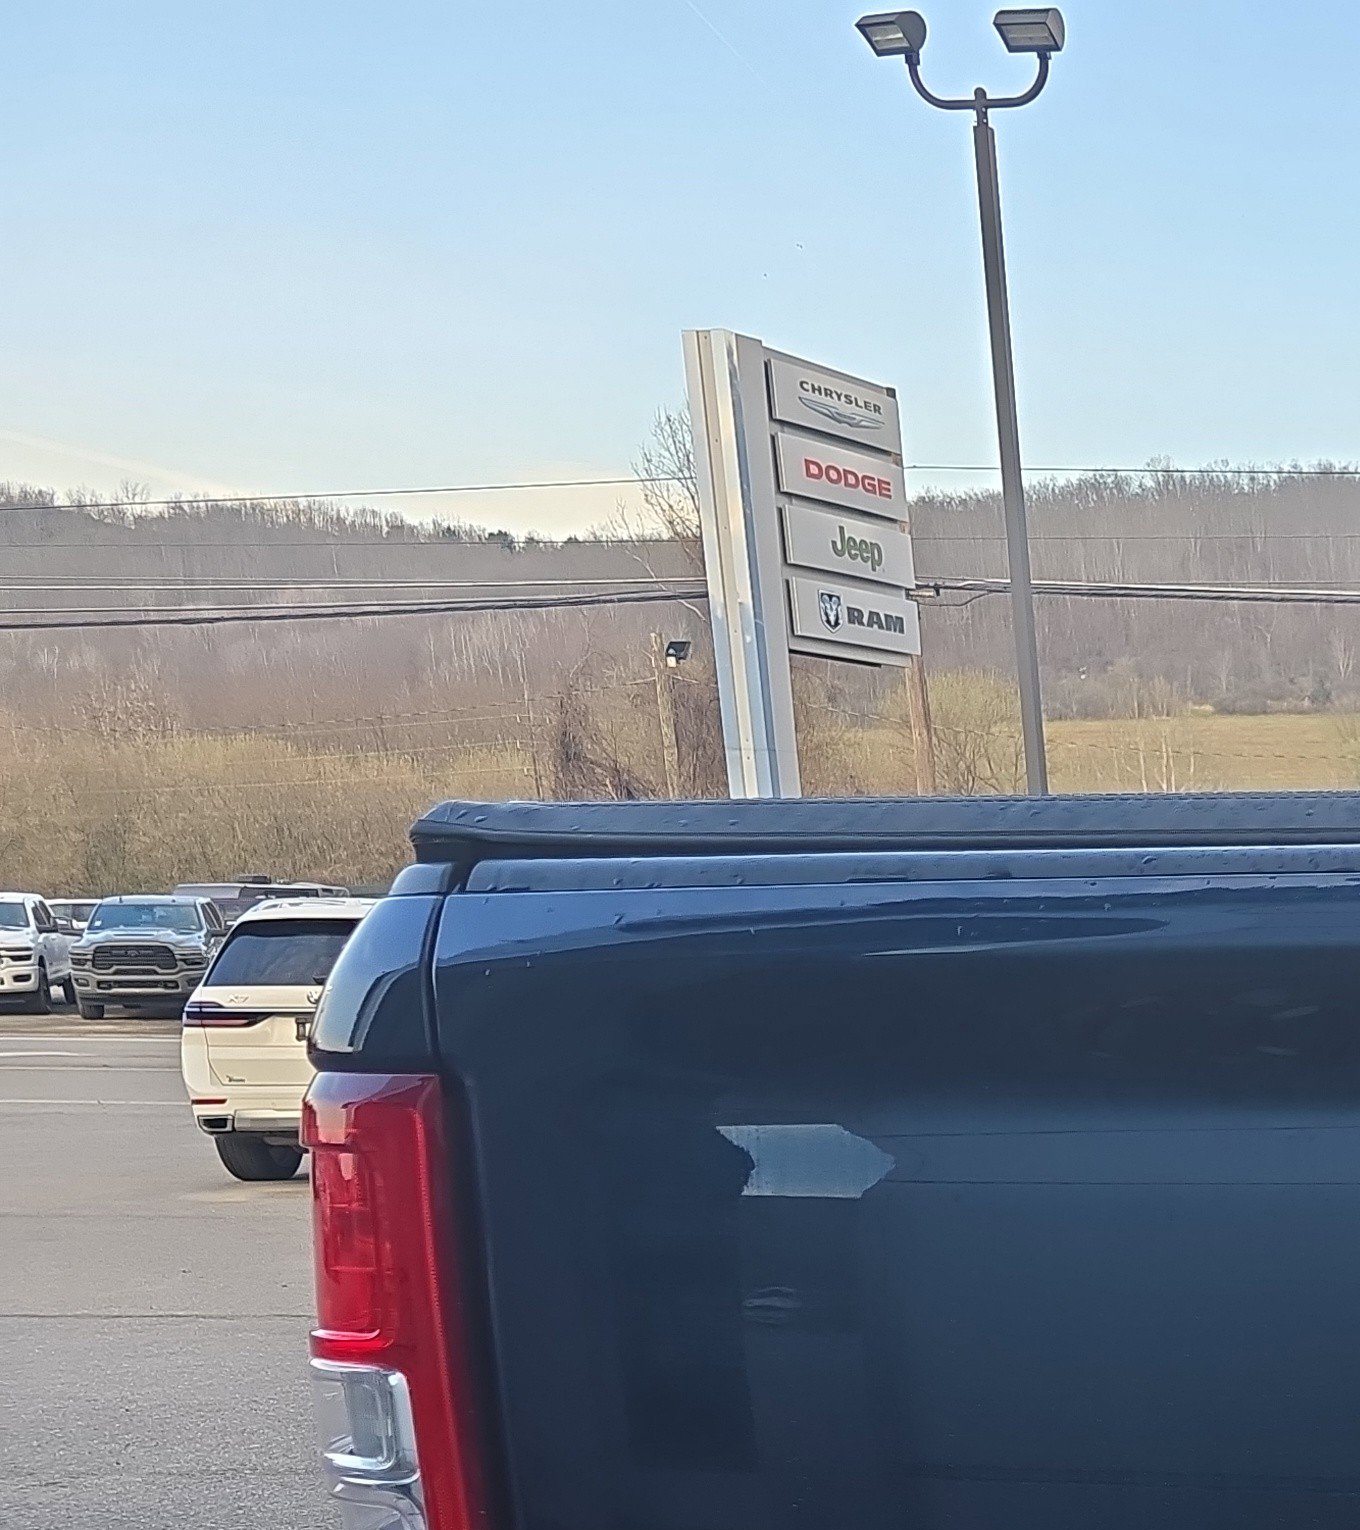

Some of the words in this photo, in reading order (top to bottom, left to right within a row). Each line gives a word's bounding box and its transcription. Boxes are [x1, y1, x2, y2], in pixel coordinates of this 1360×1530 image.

[799, 380, 883, 416] CHRYSLER
[804, 457, 893, 499] DODGE
[831, 525, 884, 572] Jeep
[847, 607, 905, 635] RAM
